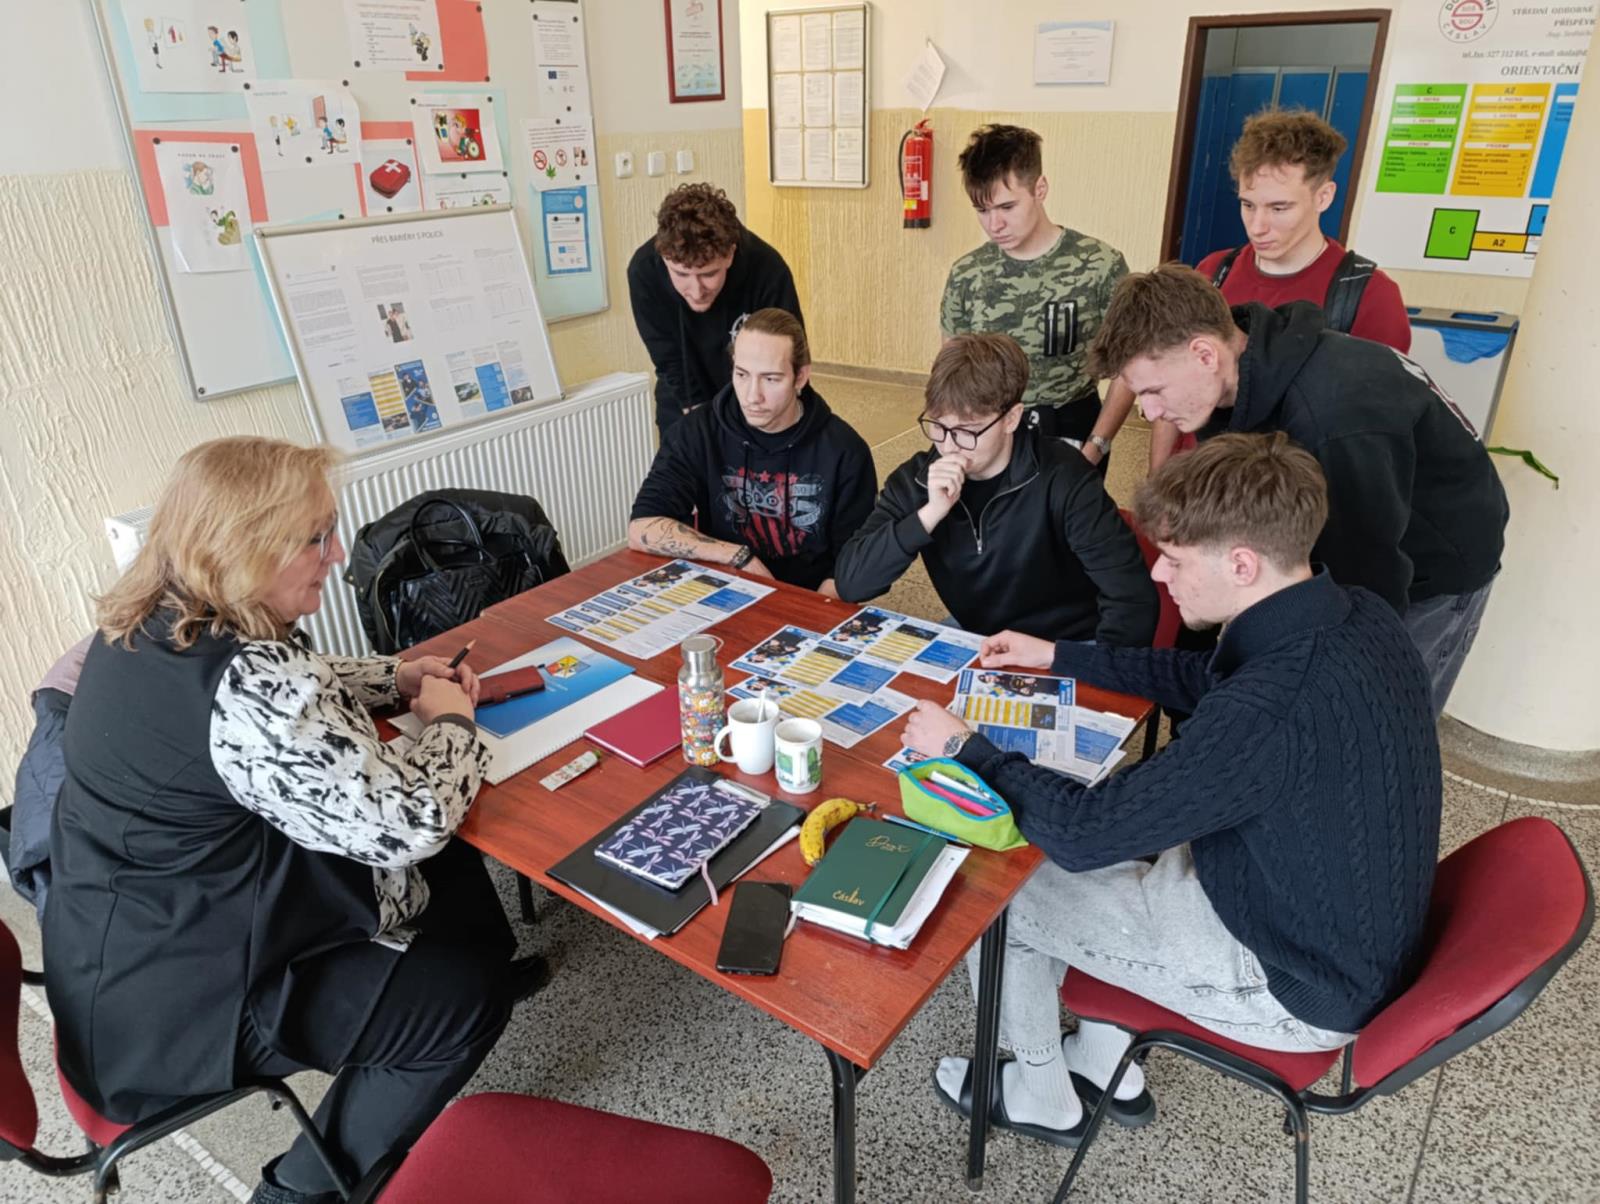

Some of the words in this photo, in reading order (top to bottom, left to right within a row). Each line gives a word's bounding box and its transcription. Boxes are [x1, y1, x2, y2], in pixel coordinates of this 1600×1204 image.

[1500, 62, 1581, 76] ORIENTAČNÍ
[1426, 87, 1433, 95] C
[1504, 87, 1516, 95] A2
[1449, 226, 1457, 235] C
[1492, 239, 1506, 247] A2
